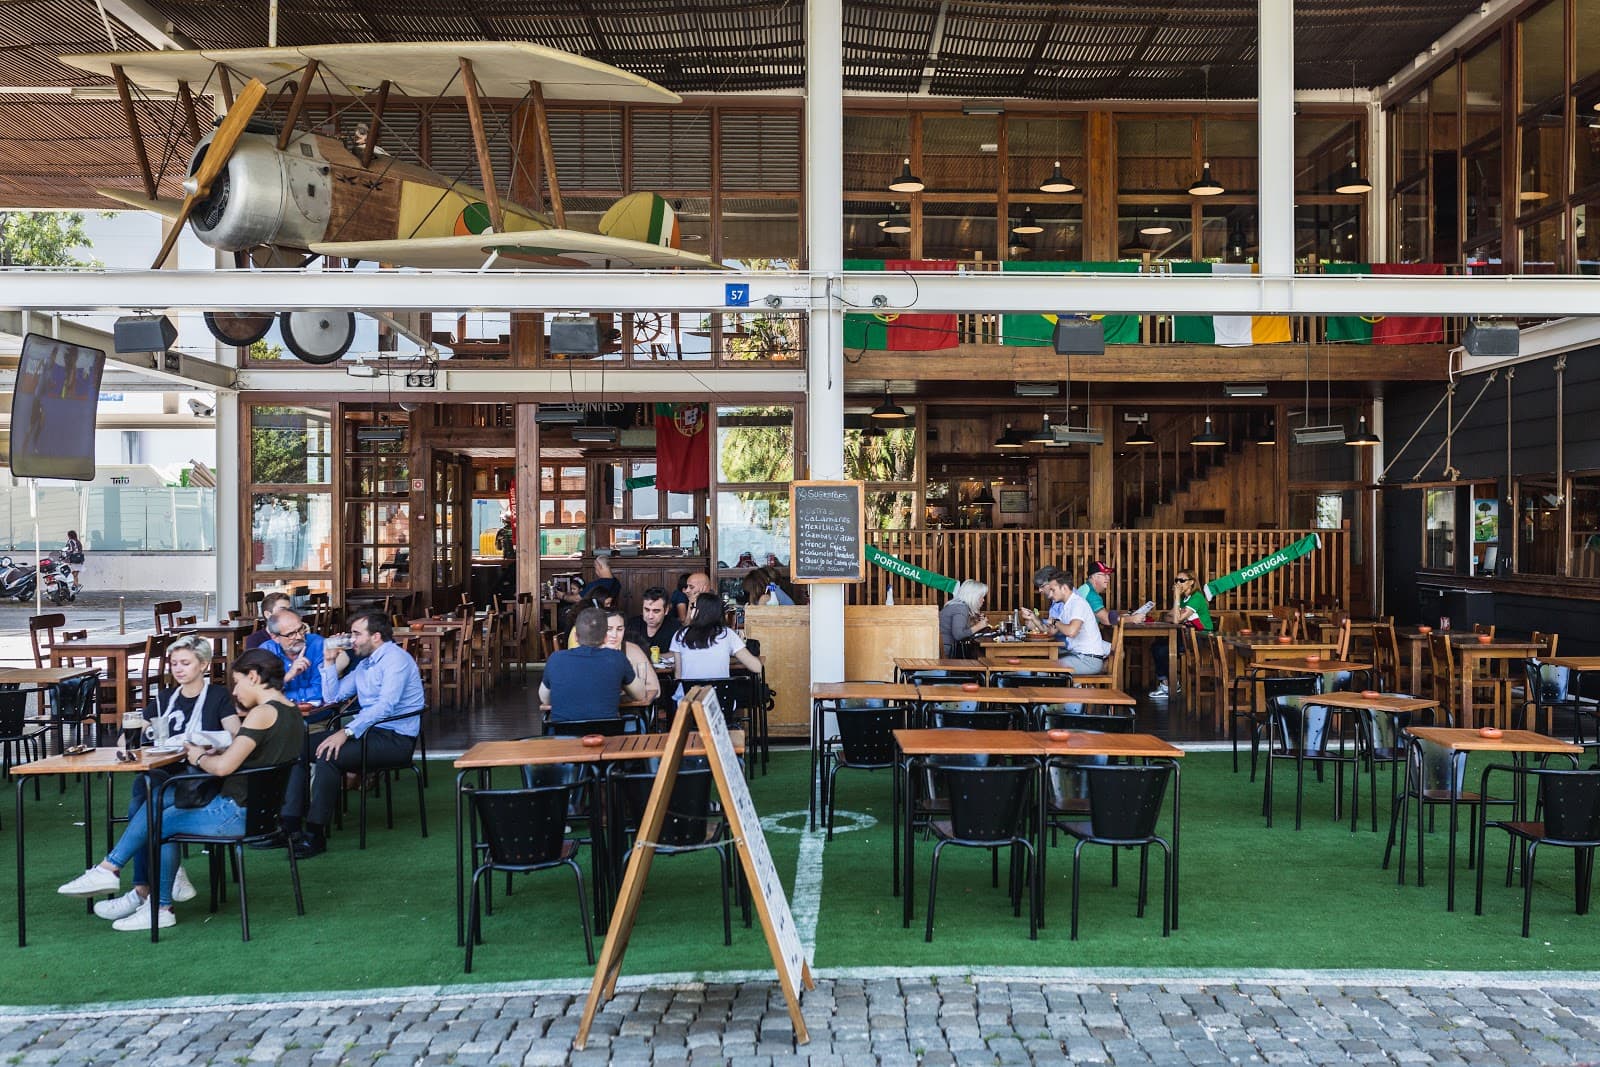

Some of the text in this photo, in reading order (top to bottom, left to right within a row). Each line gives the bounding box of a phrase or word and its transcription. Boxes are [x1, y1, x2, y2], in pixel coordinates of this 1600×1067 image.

[731, 290, 744, 300] 57
[874, 553, 921, 580] PORTUGAL
[1241, 553, 1288, 580] PORTUGAL
